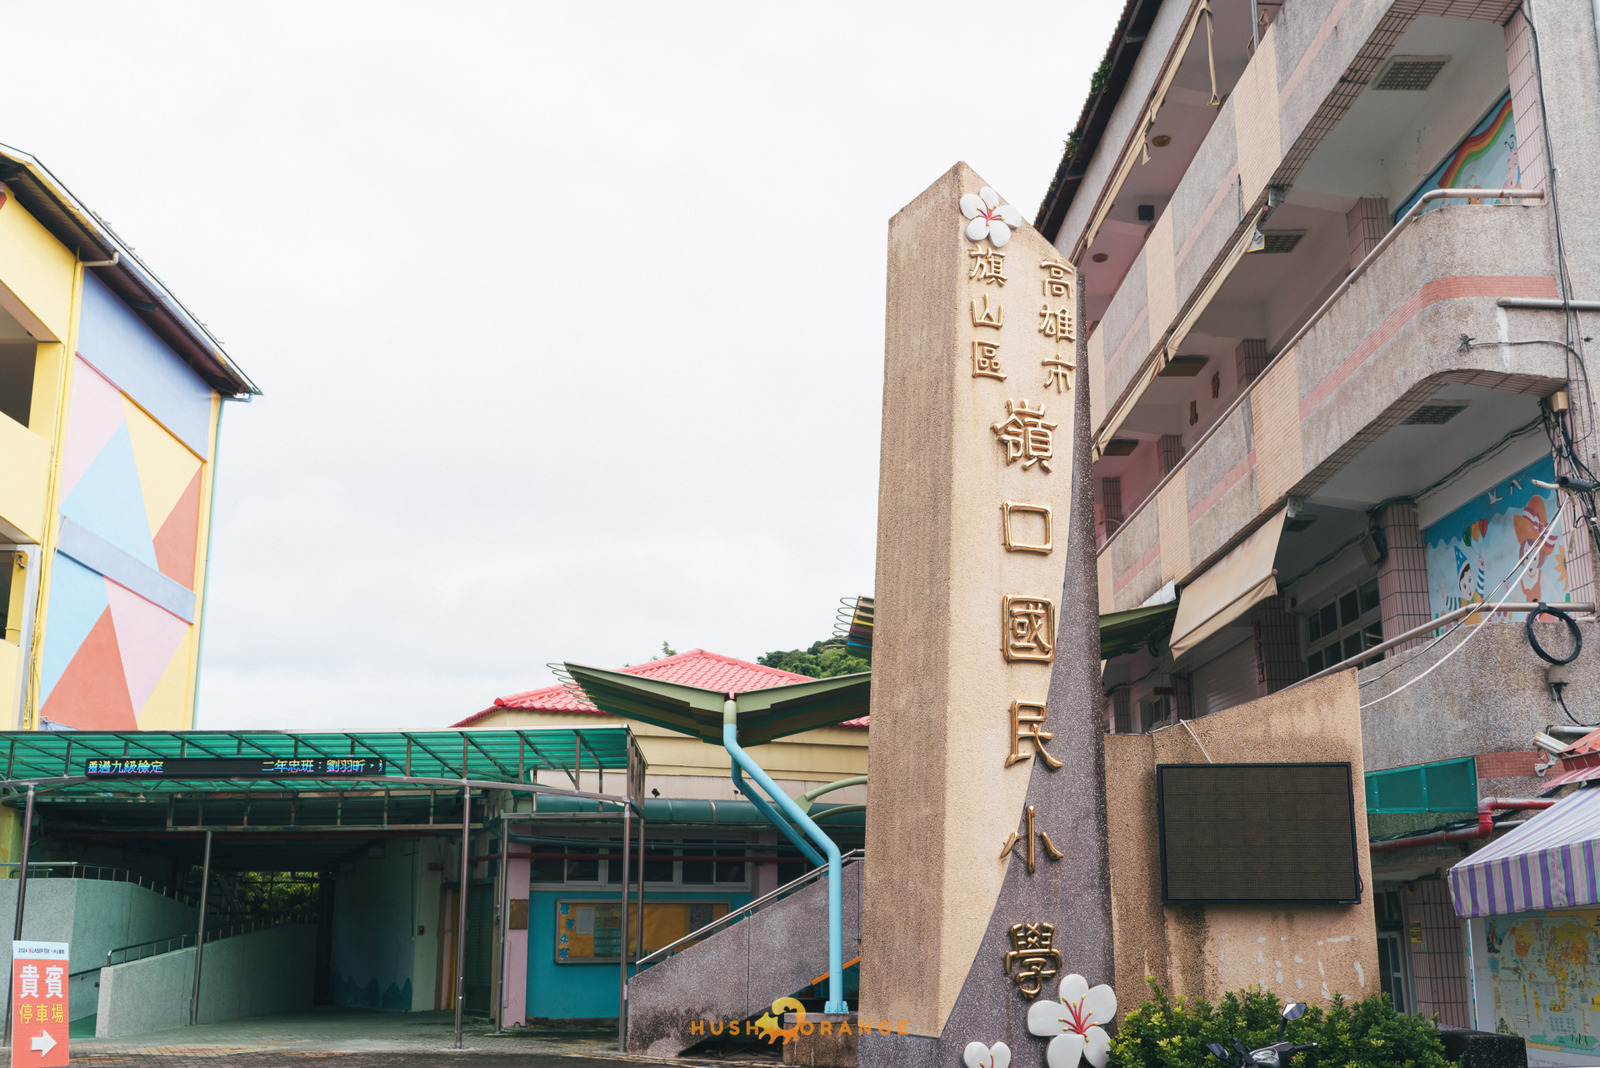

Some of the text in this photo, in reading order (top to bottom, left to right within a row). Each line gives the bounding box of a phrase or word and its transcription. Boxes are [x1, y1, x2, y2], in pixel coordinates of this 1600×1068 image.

[968, 244, 1009, 382] 旗山區
[1038, 258, 1077, 394] 高雄市
[990, 398, 1065, 1000] 嶺口國民小學
[19, 964, 64, 999] 貴賓
[19, 1003, 64, 1025] 停車場
